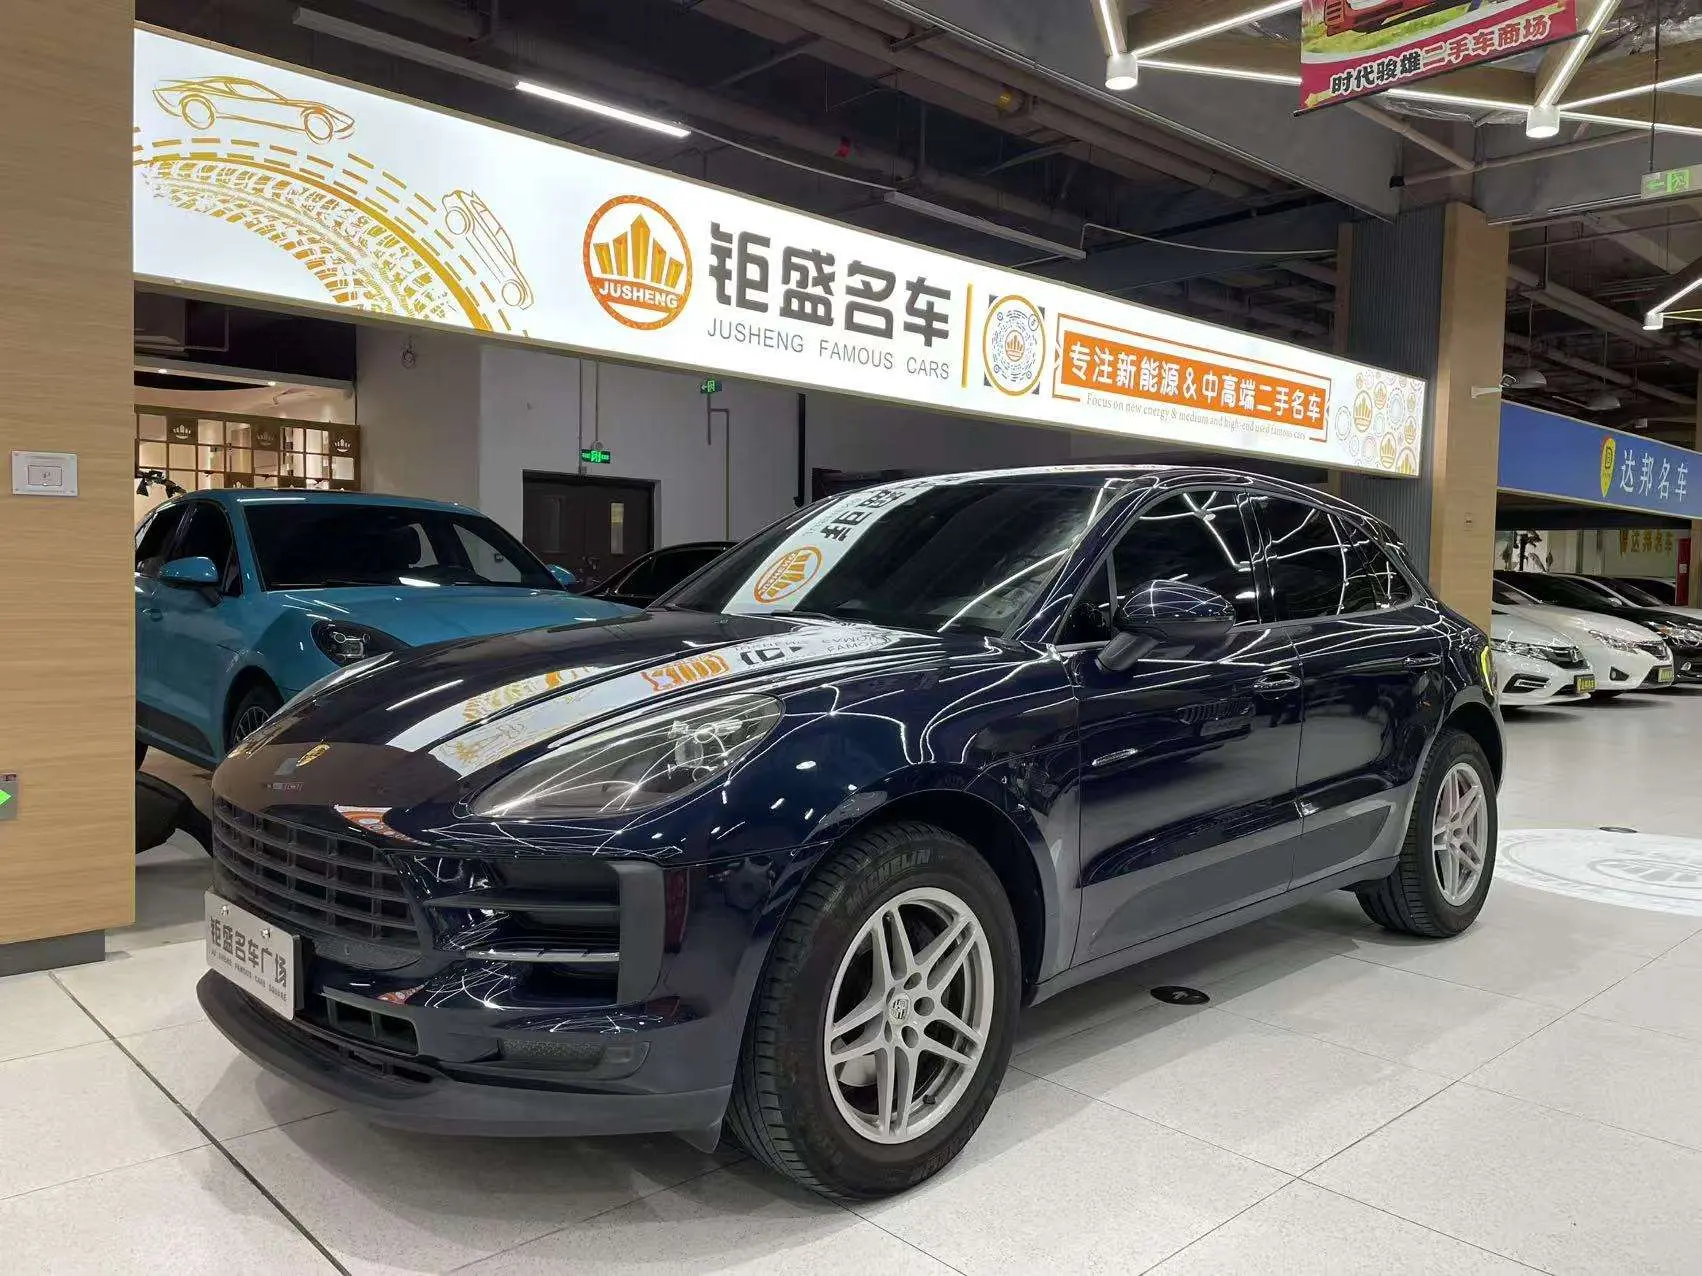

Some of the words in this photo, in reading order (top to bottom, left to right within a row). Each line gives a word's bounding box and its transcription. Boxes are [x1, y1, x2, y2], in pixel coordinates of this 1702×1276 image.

[1330, 14, 1553, 96] 时代骏雄二手车商场
[599, 280, 679, 308] JUSHENG
[708, 221, 952, 348] 钜盛名车
[707, 318, 805, 354] JUSHENG
[818, 339, 894, 371] FAMOUS
[906, 356, 950, 381] CARS
[1086, 391, 1112, 409] Focus
[1113, 400, 1124, 412] on
[1125, 402, 1143, 414] new
[1143, 405, 1169, 421] energy
[1170, 406, 1178, 419] &
[1179, 409, 1209, 425] medium
[1619, 448, 1689, 503] 达邦名车
[210, 915, 287, 988] 钜盛名车广场
